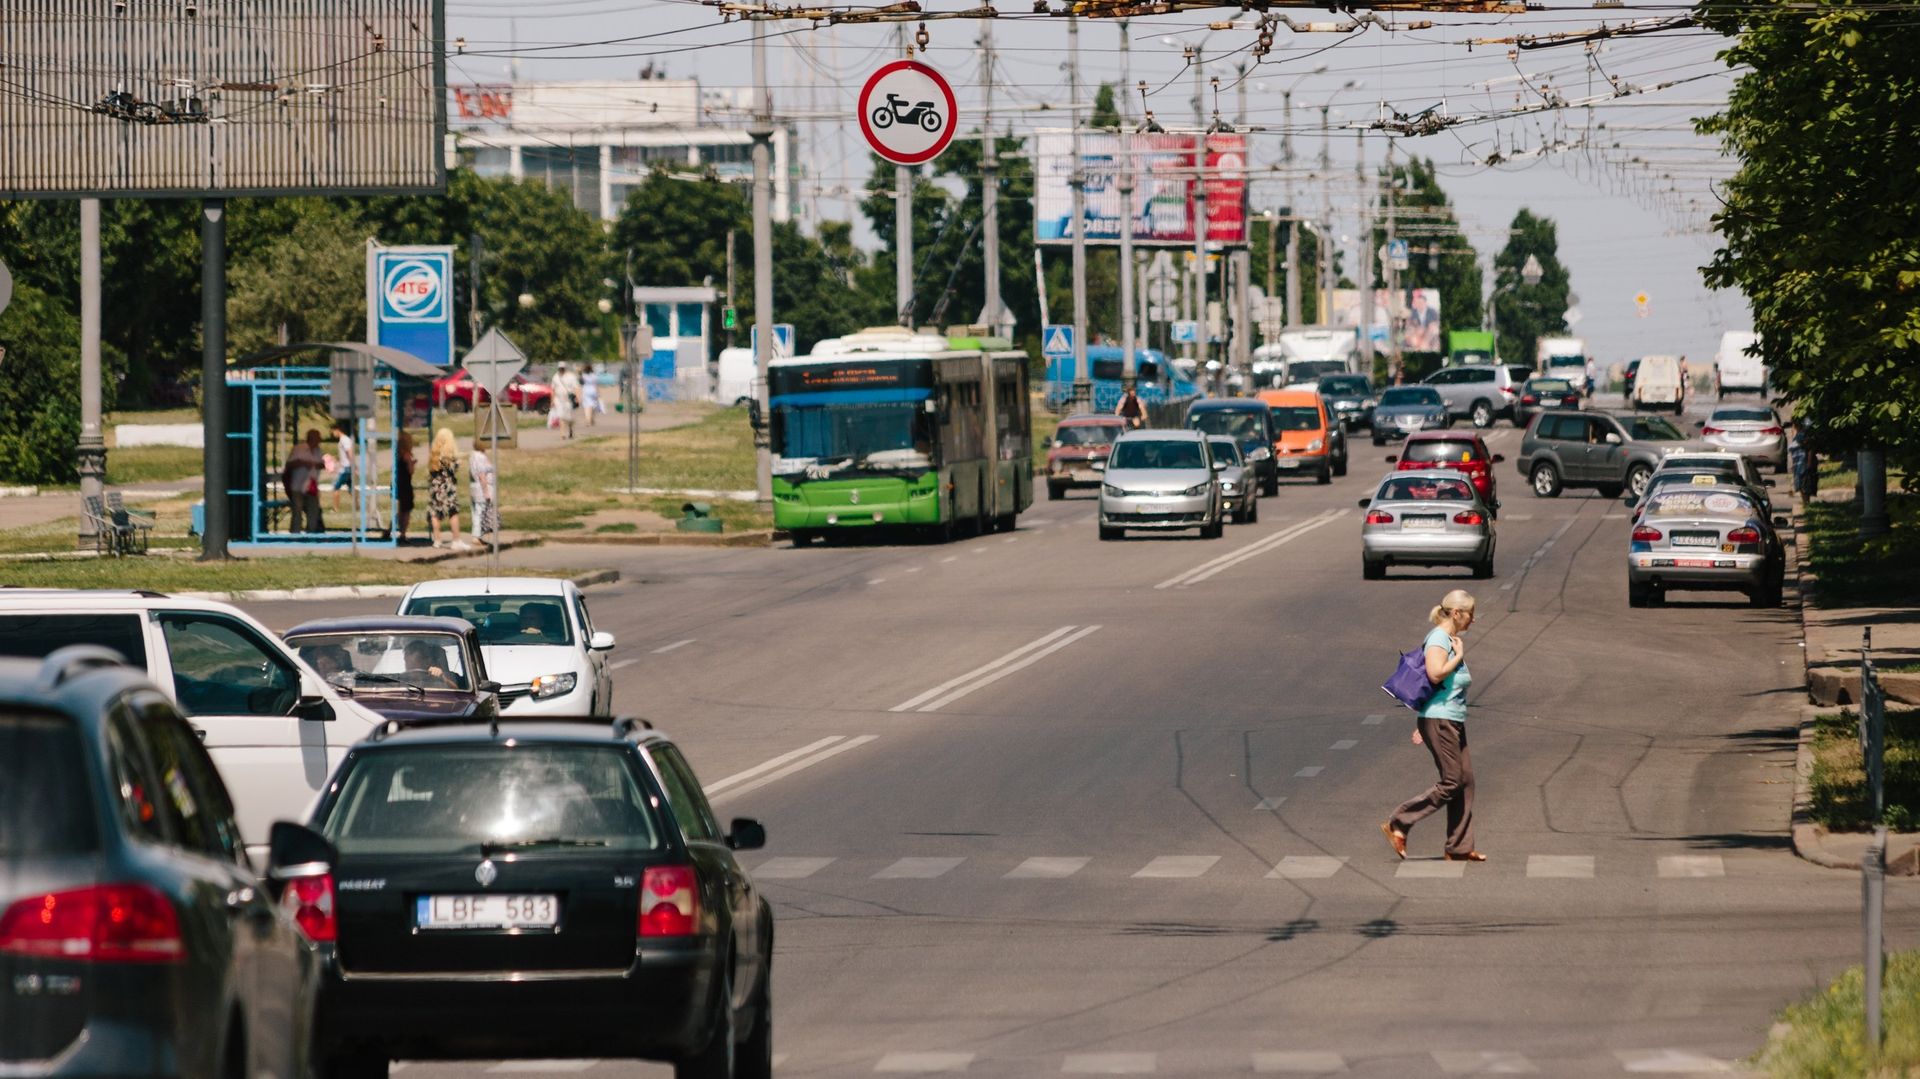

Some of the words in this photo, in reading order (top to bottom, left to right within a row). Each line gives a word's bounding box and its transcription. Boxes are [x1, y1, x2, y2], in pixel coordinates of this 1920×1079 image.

[394, 281, 428, 295] АТБ
[434, 897, 487, 921] LBF
[506, 896, 551, 920] 583
